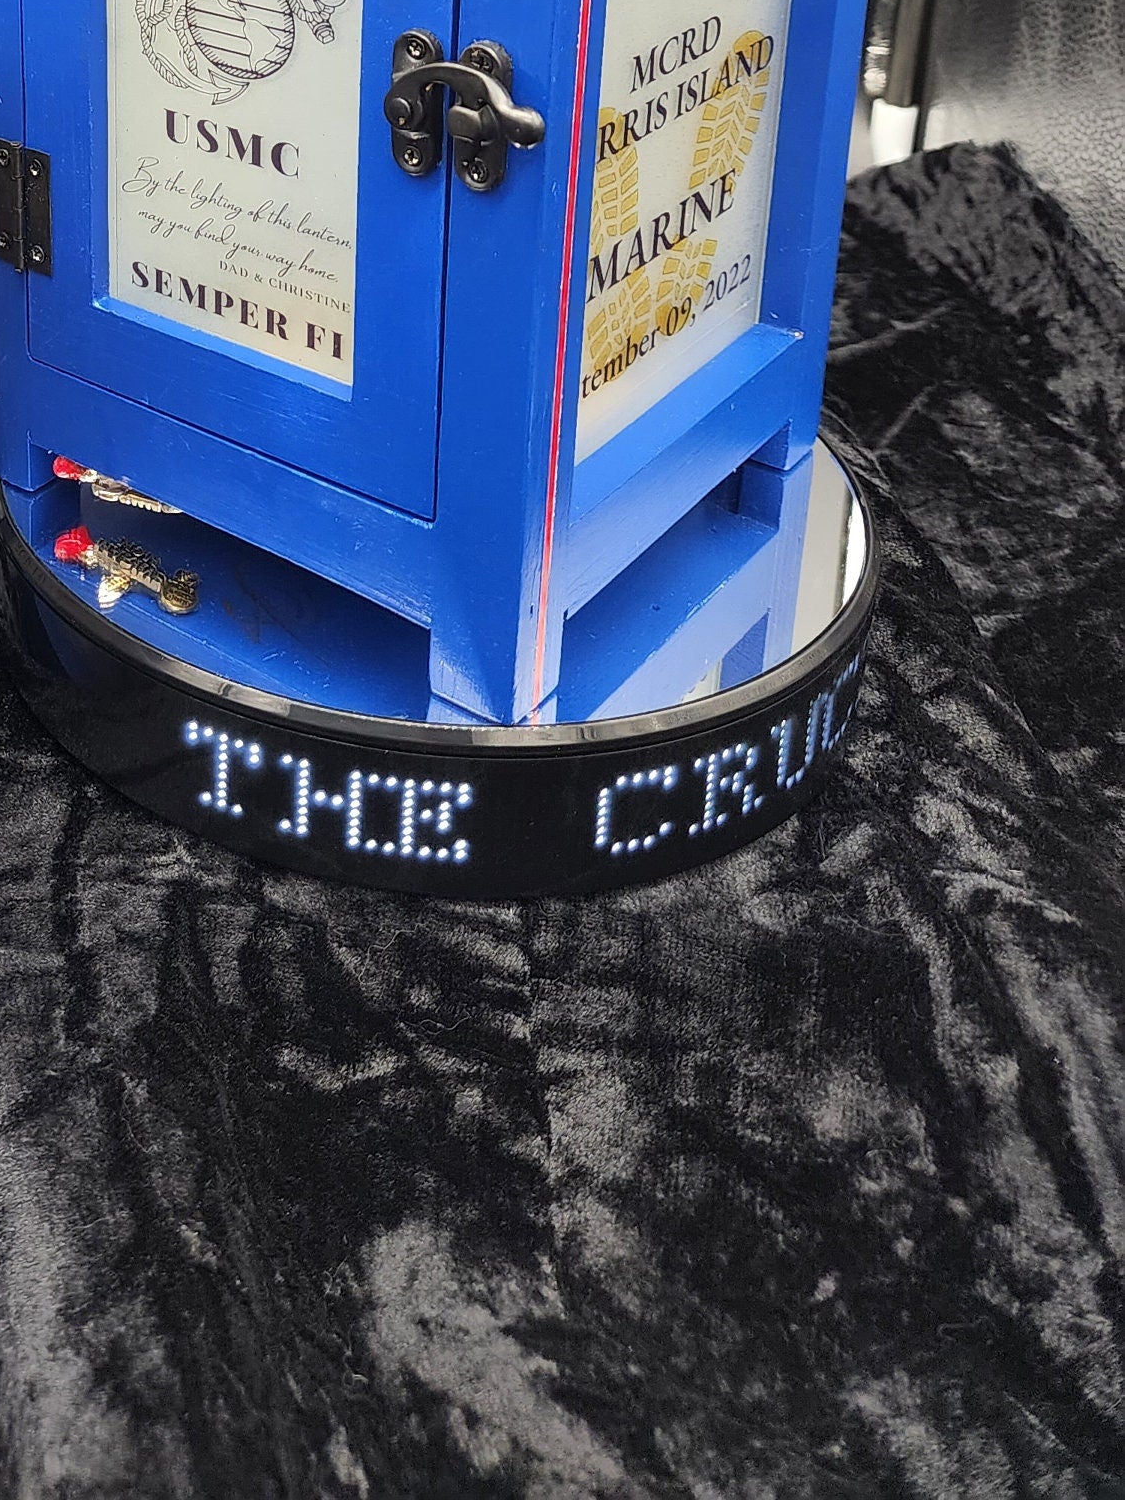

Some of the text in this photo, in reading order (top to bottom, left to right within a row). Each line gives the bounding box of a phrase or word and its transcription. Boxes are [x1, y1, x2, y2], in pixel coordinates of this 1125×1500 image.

[629, 15, 722, 94] MCRD
[598, 34, 774, 162] RRIS ISLAND
[163, 108, 300, 179] USMC
[122, 156, 161, 197] By
[164, 171, 187, 194] the
[190, 179, 242, 220] lighting
[248, 200, 274, 222] of
[267, 203, 292, 229] this
[138, 211, 338, 282] may you find your way home.
[586, 169, 738, 303] MARINE
[131, 261, 345, 361] SEMPER FI
[219, 260, 352, 313] DAD & CHRISTINE
[666, 297, 695, 336] 09,
[703, 254, 751, 311] 2022
[185, 720, 473, 863] THE
